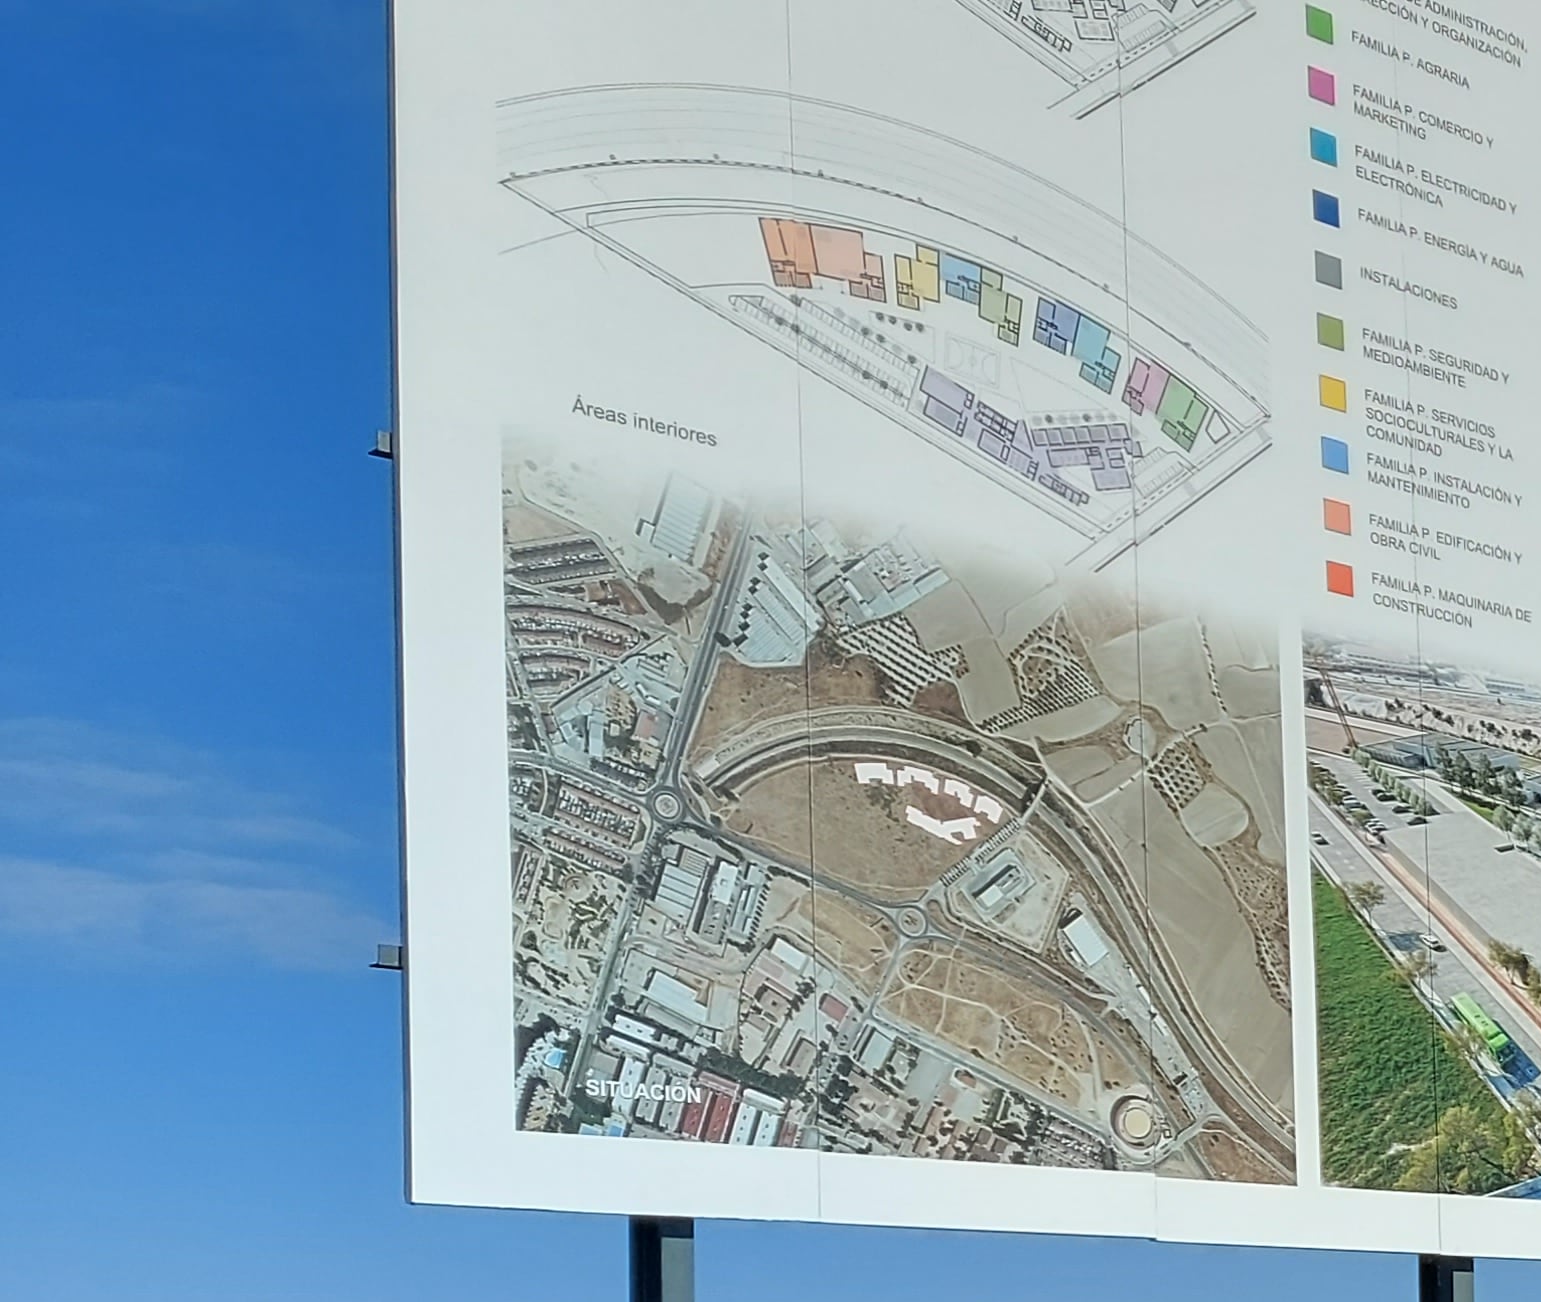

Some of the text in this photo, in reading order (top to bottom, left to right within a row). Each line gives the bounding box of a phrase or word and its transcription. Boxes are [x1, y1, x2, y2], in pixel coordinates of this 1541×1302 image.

[1421, 17, 1430, 29] Y
[1351, 30, 1400, 61] FAMILIA
[1416, 58, 1471, 90] AGRARIA
[1352, 83, 1401, 115] FAMILIA
[1418, 111, 1483, 145] COMERCIO
[1486, 136, 1494, 149] Y
[1353, 100, 1427, 140] MARKETING
[1354, 145, 1404, 175] FAMILIA
[1421, 169, 1507, 211] ELECTRICIDAD
[1509, 202, 1517, 215] Y
[1355, 165, 1444, 208] ELECTRÓNICA
[1358, 208, 1407, 238] FAMILIA
[1480, 251, 1488, 264] Y
[1491, 256, 1524, 278] AGUA
[1360, 266, 1458, 310] INSTALACIONES
[1362, 328, 1412, 354] FAMILIA
[1429, 348, 1499, 382] SEGURIDAD
[1501, 372, 1510, 385] Y
[1363, 345, 1467, 388] MEDIOAMBIENTE
[572, 394, 718, 447] Áreas interiores
[1364, 389, 1414, 415] FAMILIA
[1431, 408, 1496, 439] SERVICIOS
[1366, 407, 1514, 461] SOCIOCULTURALES Y LA
[1366, 424, 1442, 457] COMUNIDAD
[1366, 453, 1417, 477] FAMILIA
[1434, 471, 1512, 506] INSTALACIÓN
[1514, 495, 1522, 508] Y
[1367, 470, 1471, 510] MANTENIMIENTO
[1369, 513, 1420, 538] FAMILIA
[1436, 530, 1512, 564] EDIFICACIÓN
[1514, 553, 1523, 565] Y
[1370, 532, 1441, 561] OBRA CIVIL
[1371, 572, 1421, 595] FAMILIA
[1438, 588, 1513, 620] MAQUINARIA
[1515, 608, 1533, 624] DE
[585, 1078, 702, 1104] SITUACIÓN
